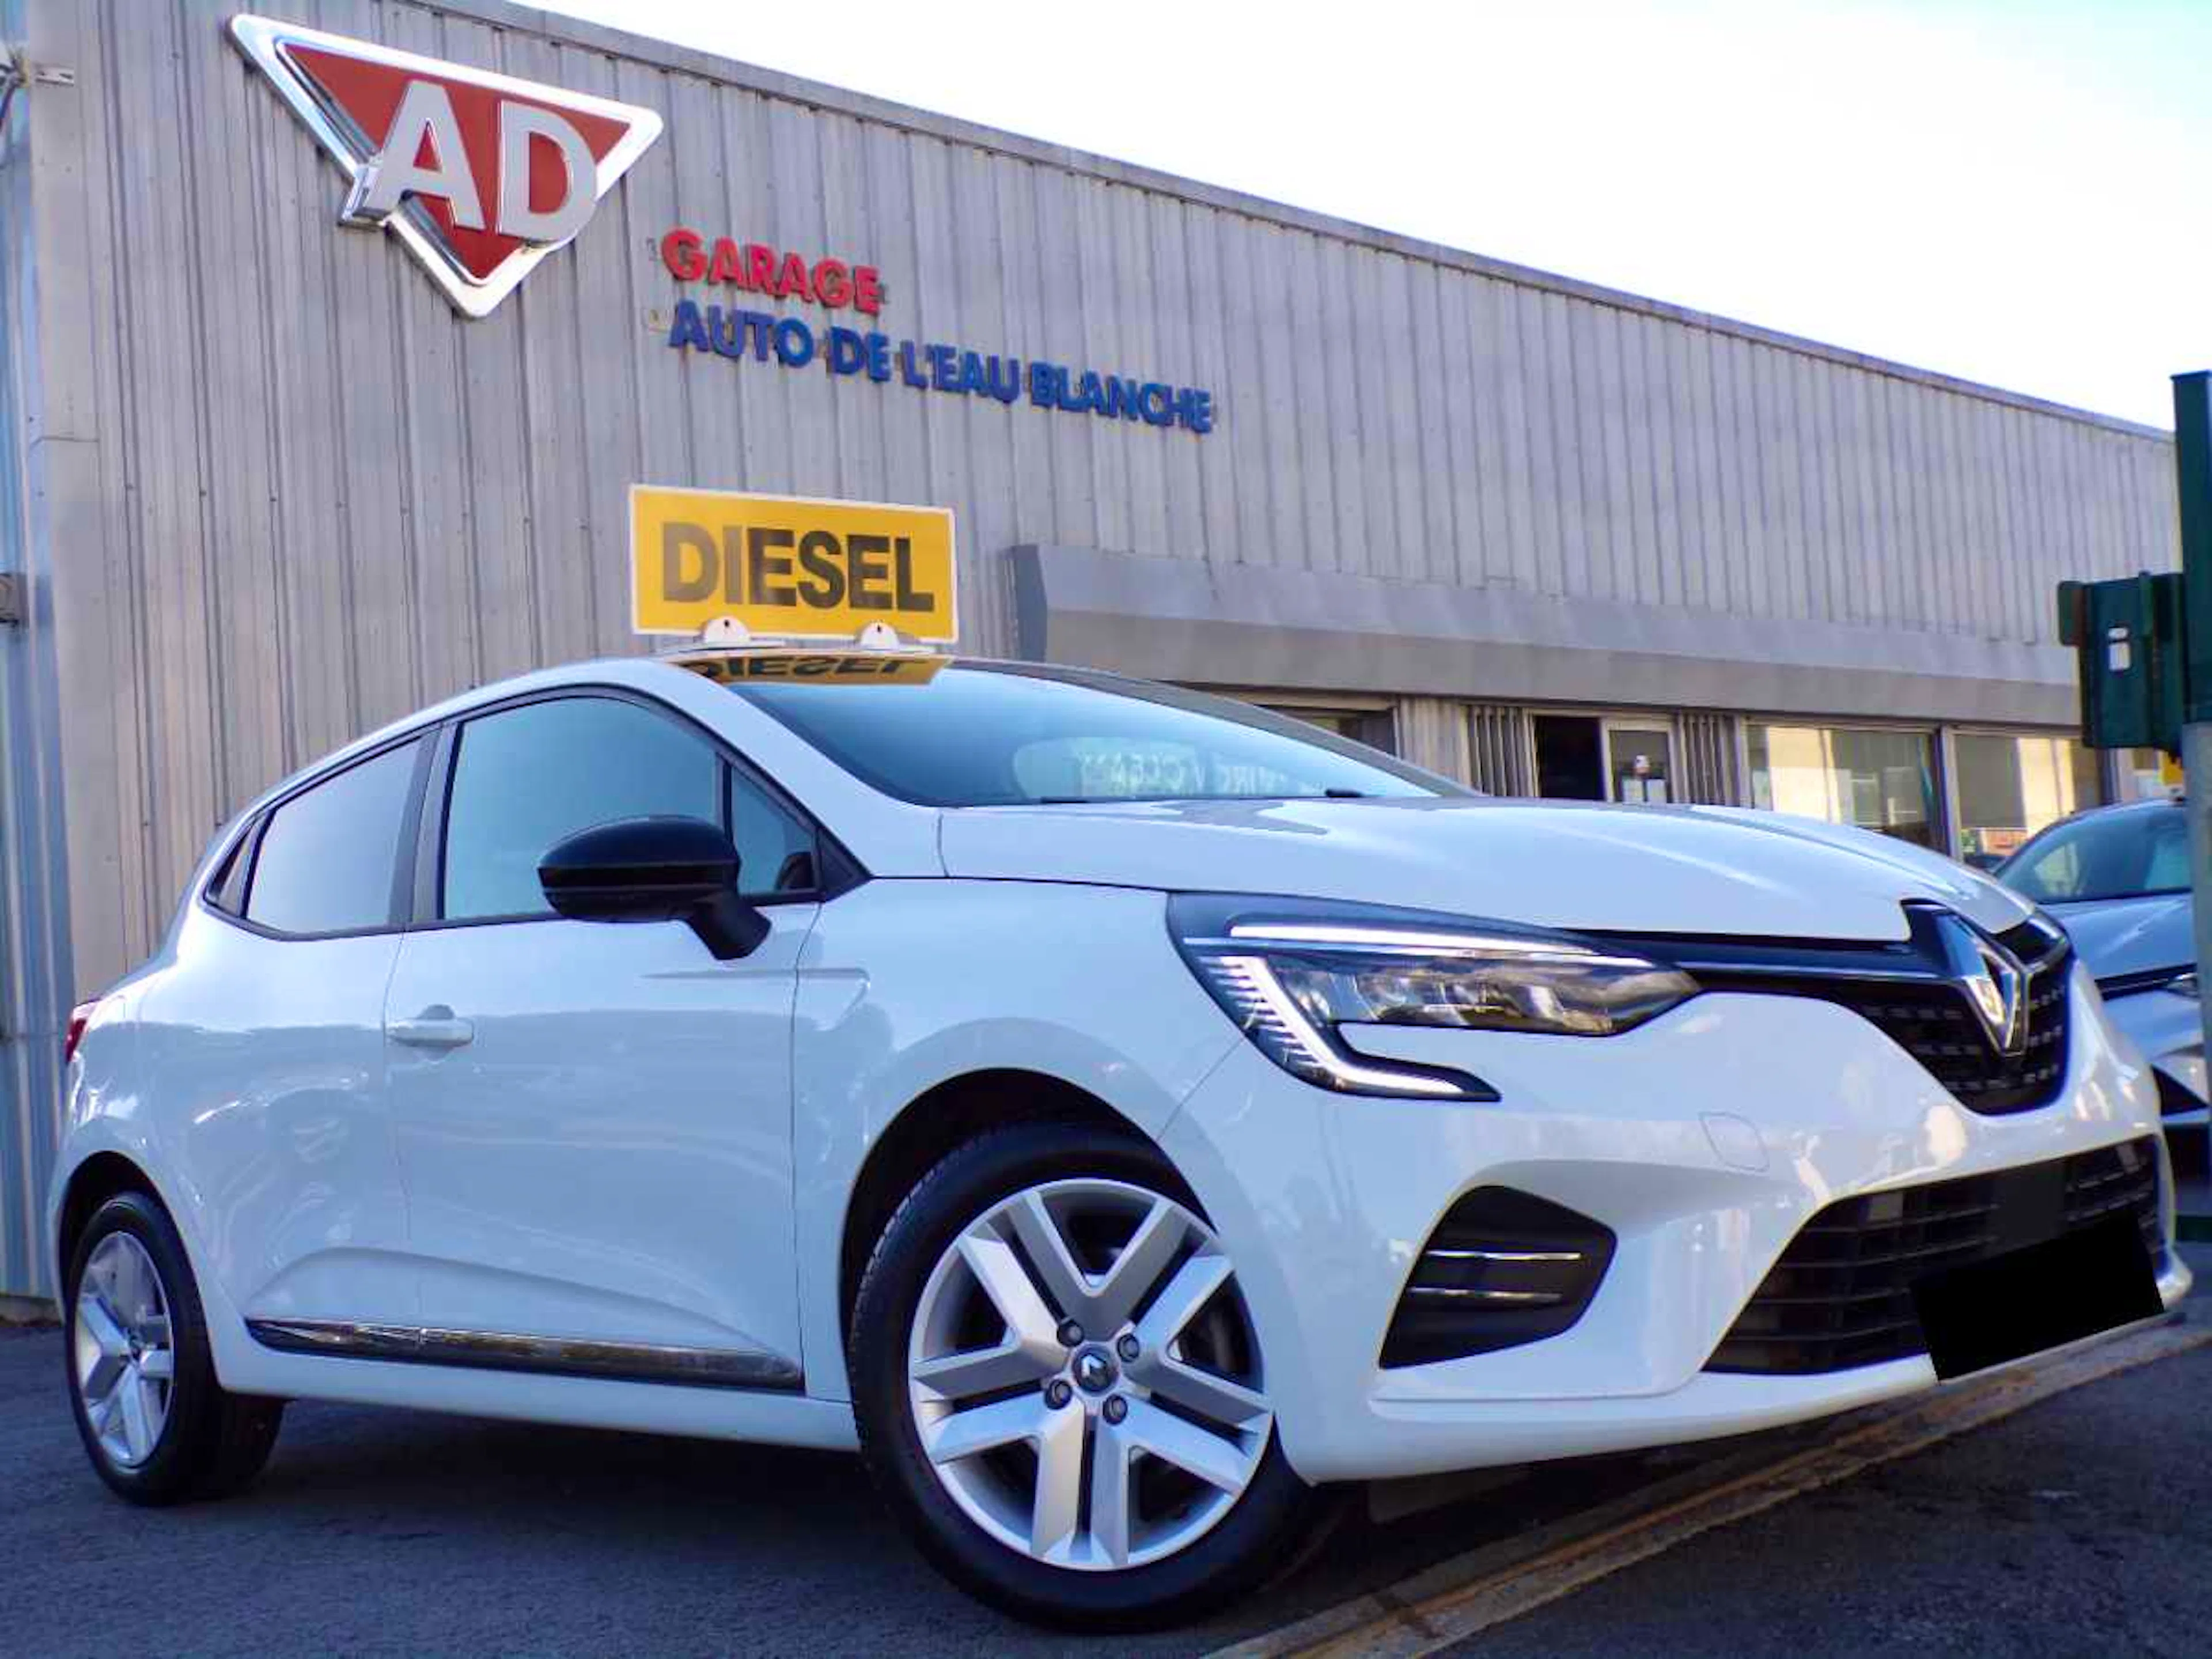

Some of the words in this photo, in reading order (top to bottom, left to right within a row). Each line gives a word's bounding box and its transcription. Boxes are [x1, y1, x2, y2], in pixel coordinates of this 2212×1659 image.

[349, 79, 598, 242] AD
[661, 228, 880, 316] GARAGE
[669, 299, 814, 368] AUTO
[828, 326, 891, 382] DE
[900, 339, 1020, 403] L'EAU
[1029, 361, 1213, 433] BLANCHE
[661, 522, 935, 612] DIESEL
